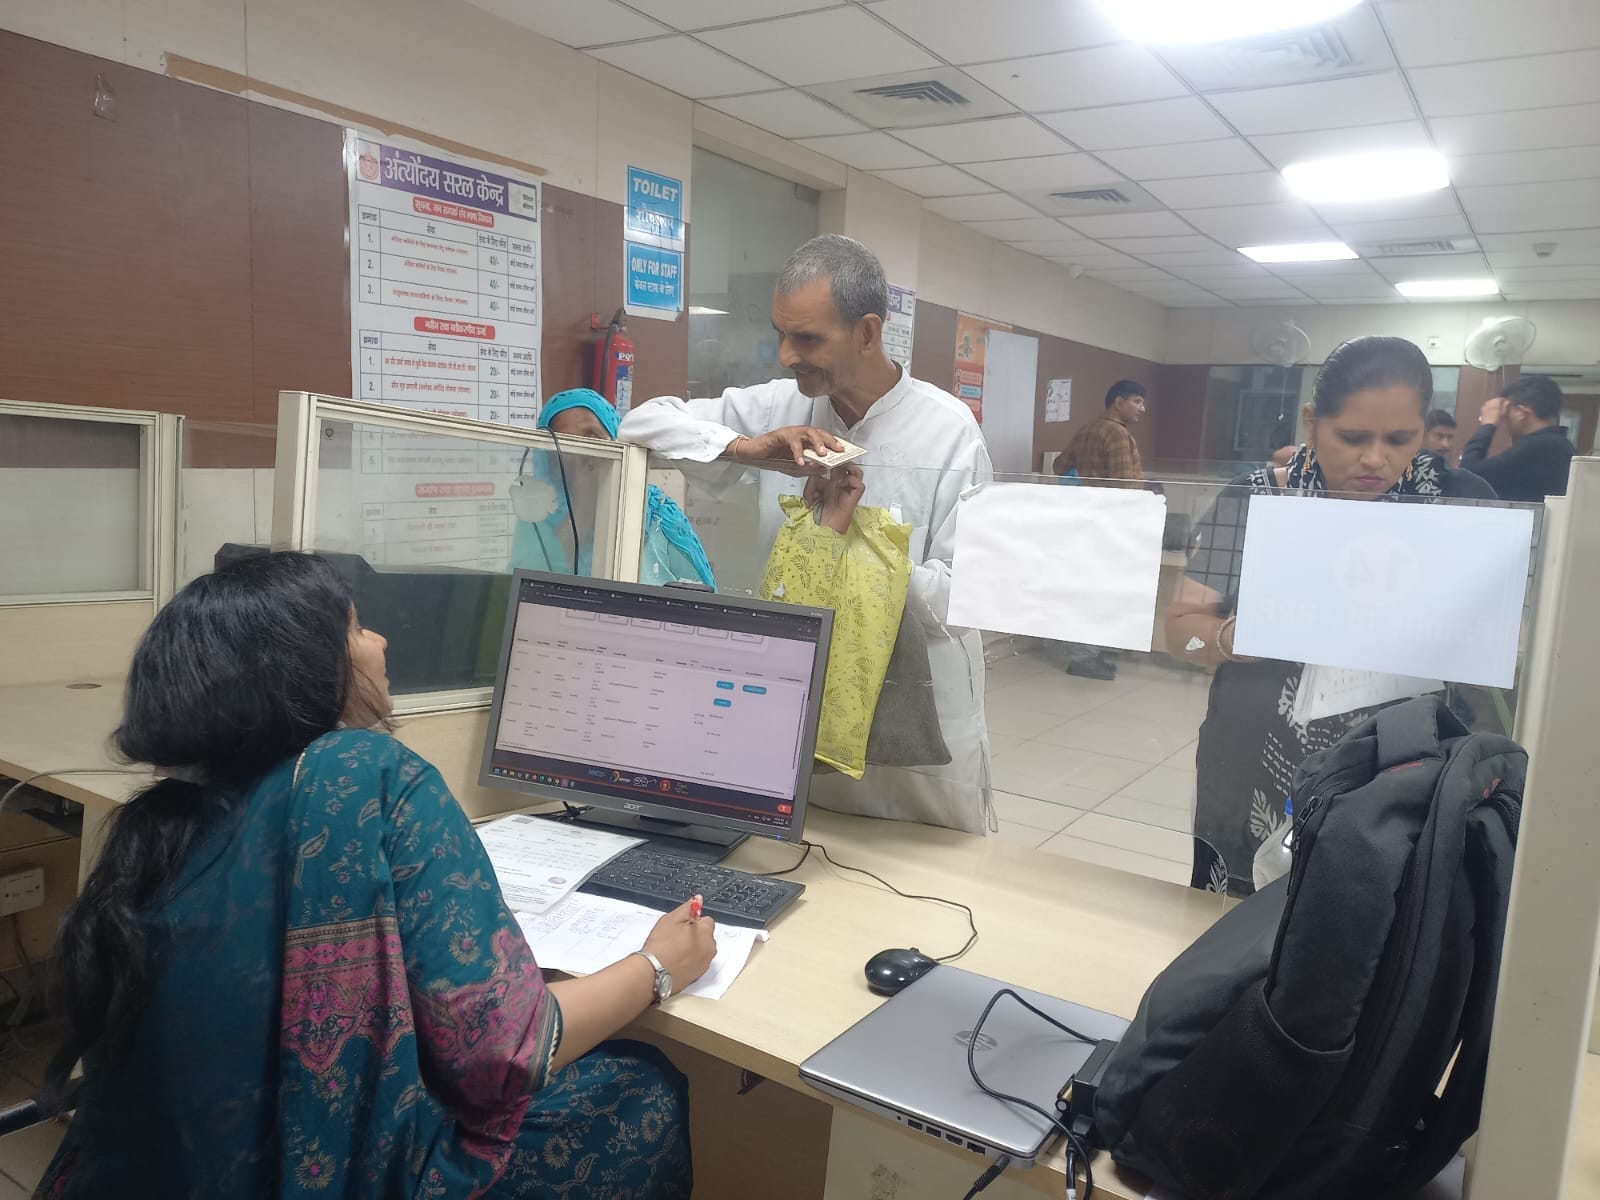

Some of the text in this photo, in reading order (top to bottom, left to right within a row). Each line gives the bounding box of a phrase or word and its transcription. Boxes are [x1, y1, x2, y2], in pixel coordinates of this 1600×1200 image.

[443, 170, 474, 198] सरल
[476, 174, 505, 206] केन्द्र
[632, 177, 678, 202] TOILET
[631, 257, 678, 280] ONLY FOR STAFF
[624, 803, 642, 811] acer
